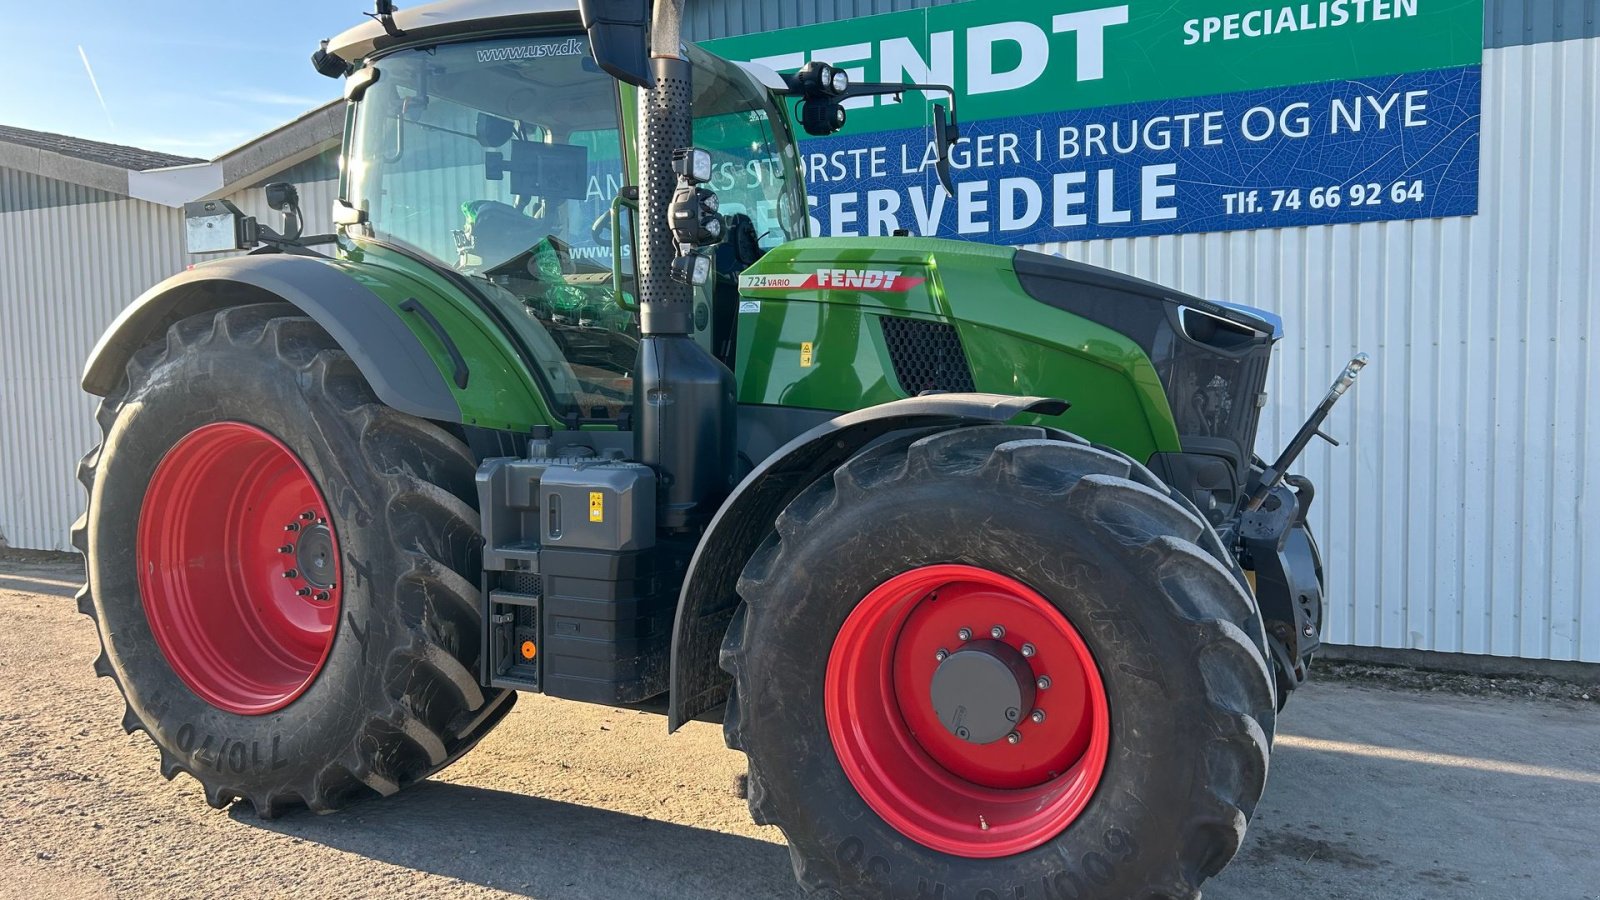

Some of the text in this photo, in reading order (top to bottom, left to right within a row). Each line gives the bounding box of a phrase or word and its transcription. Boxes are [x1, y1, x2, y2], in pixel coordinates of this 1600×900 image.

[1183, 0, 1418, 45] SPECIALISTEN
[477, 39, 582, 62] www.usv.dk
[902, 133, 1020, 174] LAGER
[1036, 129, 1041, 161] I
[1060, 110, 1224, 160] BRUGTE
[1241, 102, 1310, 142] OG
[1331, 90, 1429, 134] NYE
[1222, 179, 1425, 215] Tlf. 74 66 92 64
[747, 268, 902, 289] 724 VARIO FENDT
[175, 722, 288, 774] 710/70
